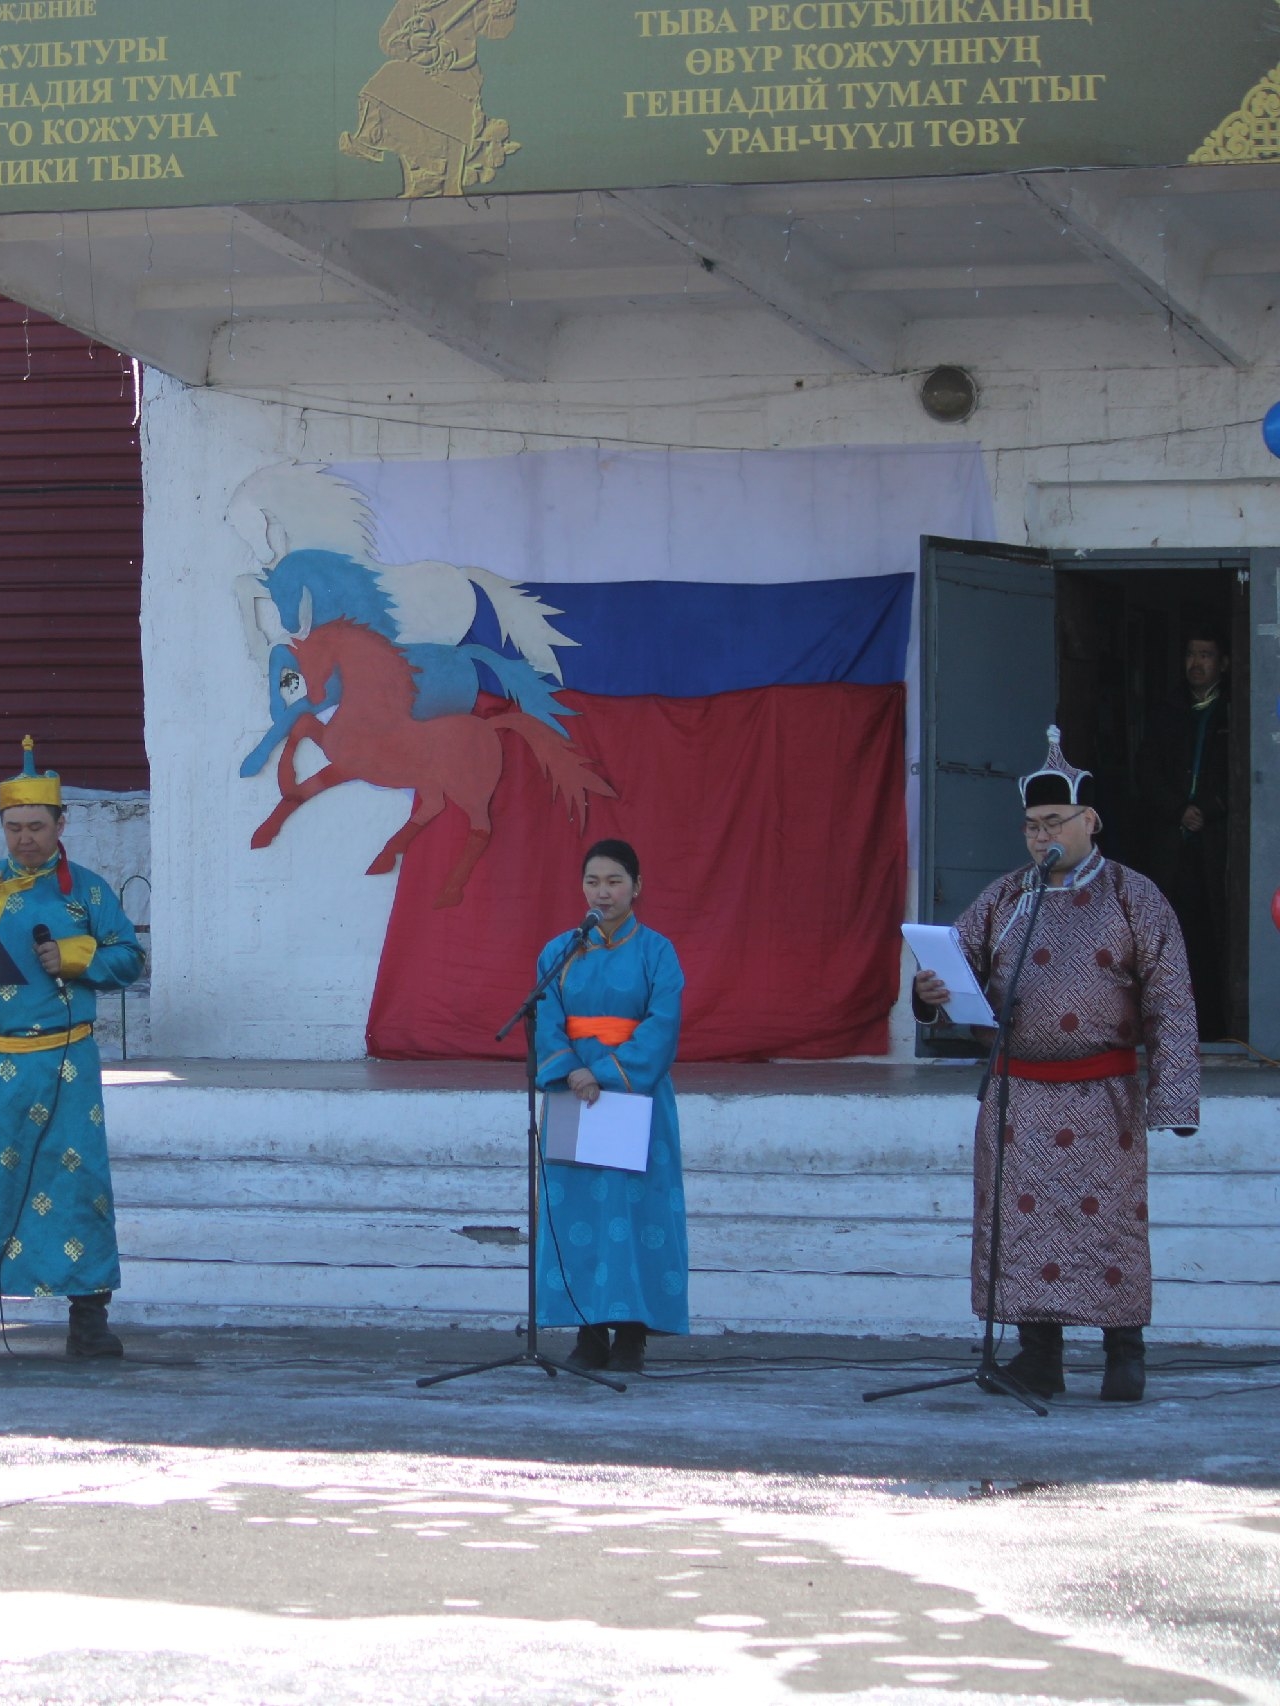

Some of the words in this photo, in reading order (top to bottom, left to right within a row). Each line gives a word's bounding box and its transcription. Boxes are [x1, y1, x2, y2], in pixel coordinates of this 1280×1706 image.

[634, 7, 738, 38] ТЫВА
[748, 0, 1094, 32] РЕСПУБЛИКАНЫҢ
[685, 44, 783, 76] ӨВҮР
[792, 35, 1041, 71] КОЖУУННУҢ
[121, 71, 242, 102] ТУМАТ
[623, 77, 829, 119] ГЕННАДИЙ
[838, 77, 967, 111] ТУМАТ
[977, 73, 1107, 105] АТТЫГ
[41, 112, 218, 147] КОЖУУНА
[923, 117, 1027, 149] ТӨВҮ
[87, 153, 184, 182] ТЫВА
